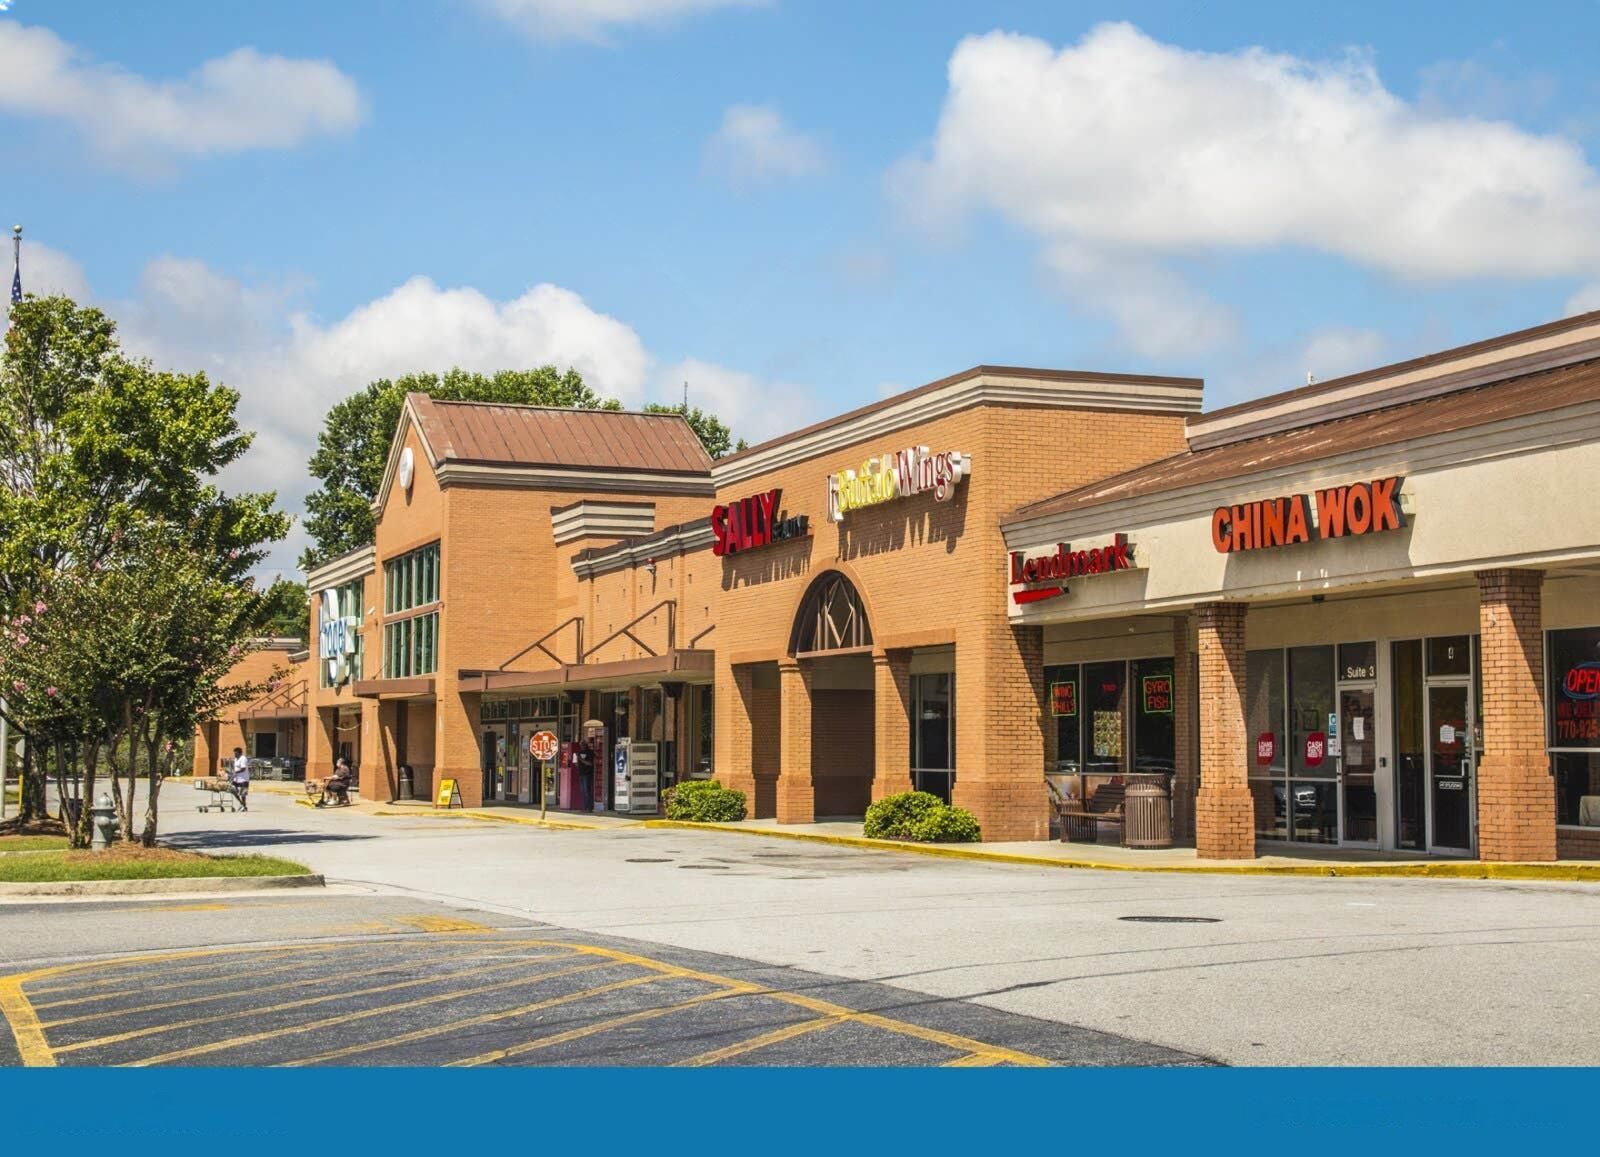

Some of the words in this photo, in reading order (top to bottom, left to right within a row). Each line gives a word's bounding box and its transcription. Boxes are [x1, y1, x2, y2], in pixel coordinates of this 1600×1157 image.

[896, 446, 961, 502] Wings
[712, 489, 781, 556] SALLY
[1212, 494, 1309, 553] CHINA
[1315, 477, 1403, 539] WOK
[1009, 533, 1133, 585] Lendmark
[1347, 666, 1366, 679] Suite
[1369, 665, 1375, 677] 3
[1147, 696, 1169, 709] FISH
[532, 740, 557, 752] STOP
